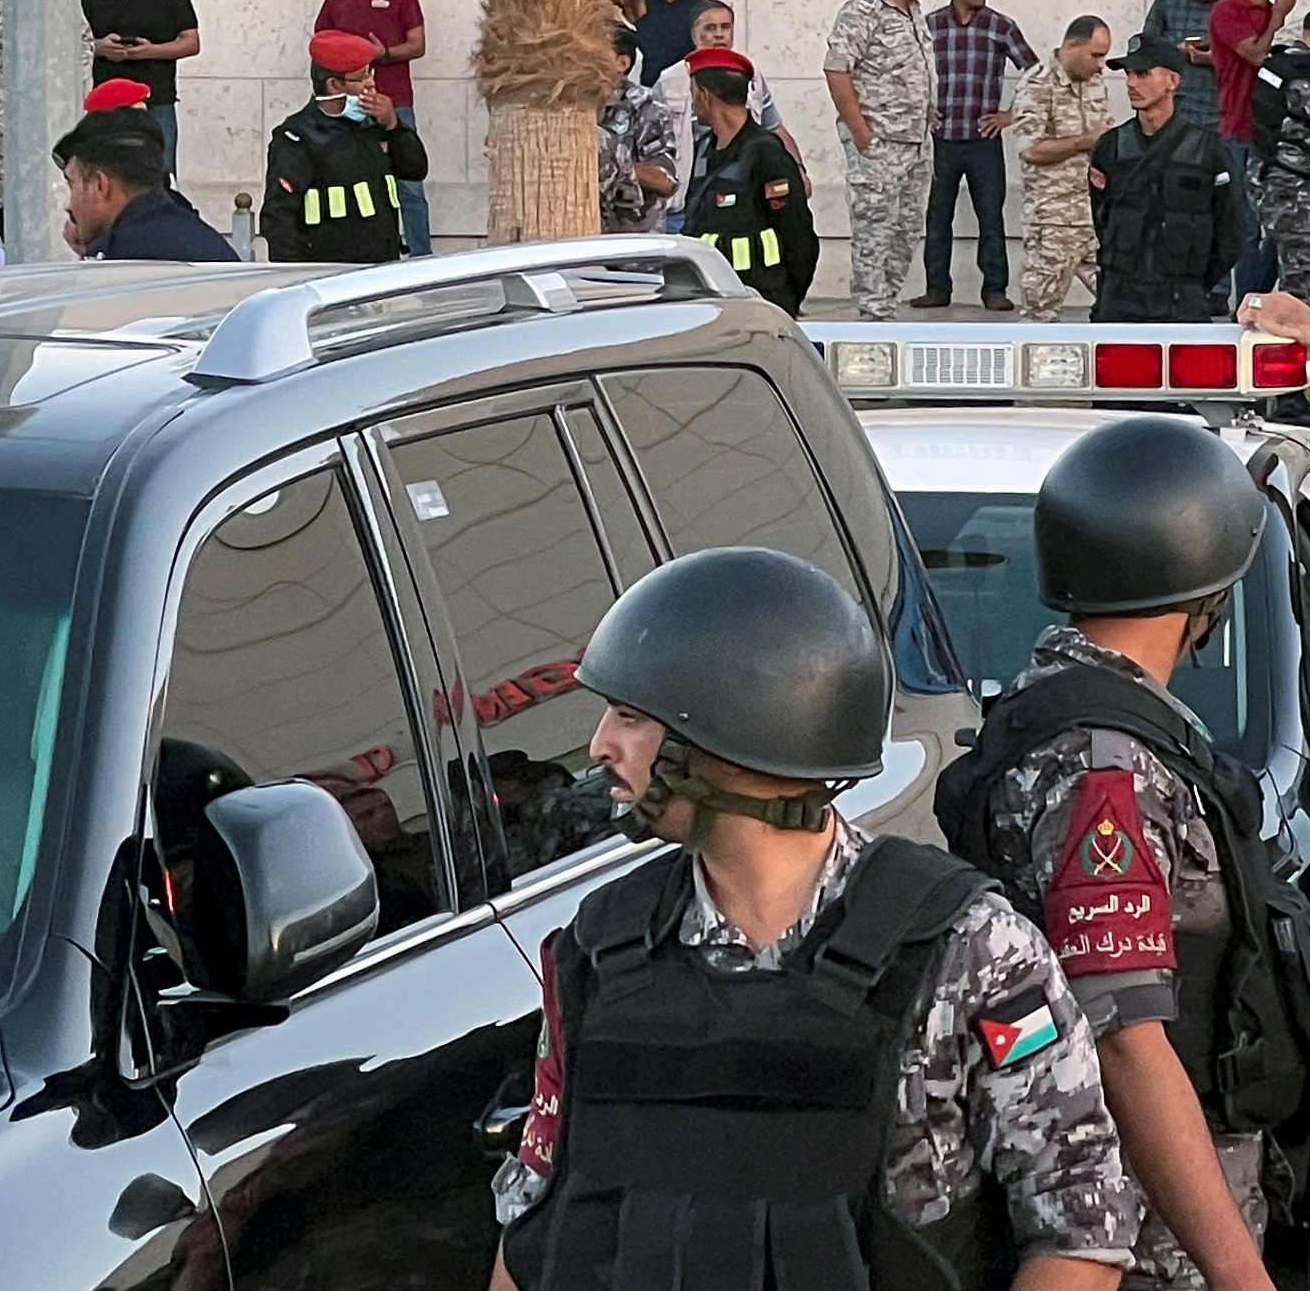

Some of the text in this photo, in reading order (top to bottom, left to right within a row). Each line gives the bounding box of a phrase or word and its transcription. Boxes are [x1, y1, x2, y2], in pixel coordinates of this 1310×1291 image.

[1068, 894, 1151, 925] الرد السريع
[1096, 930, 1133, 959] درك
